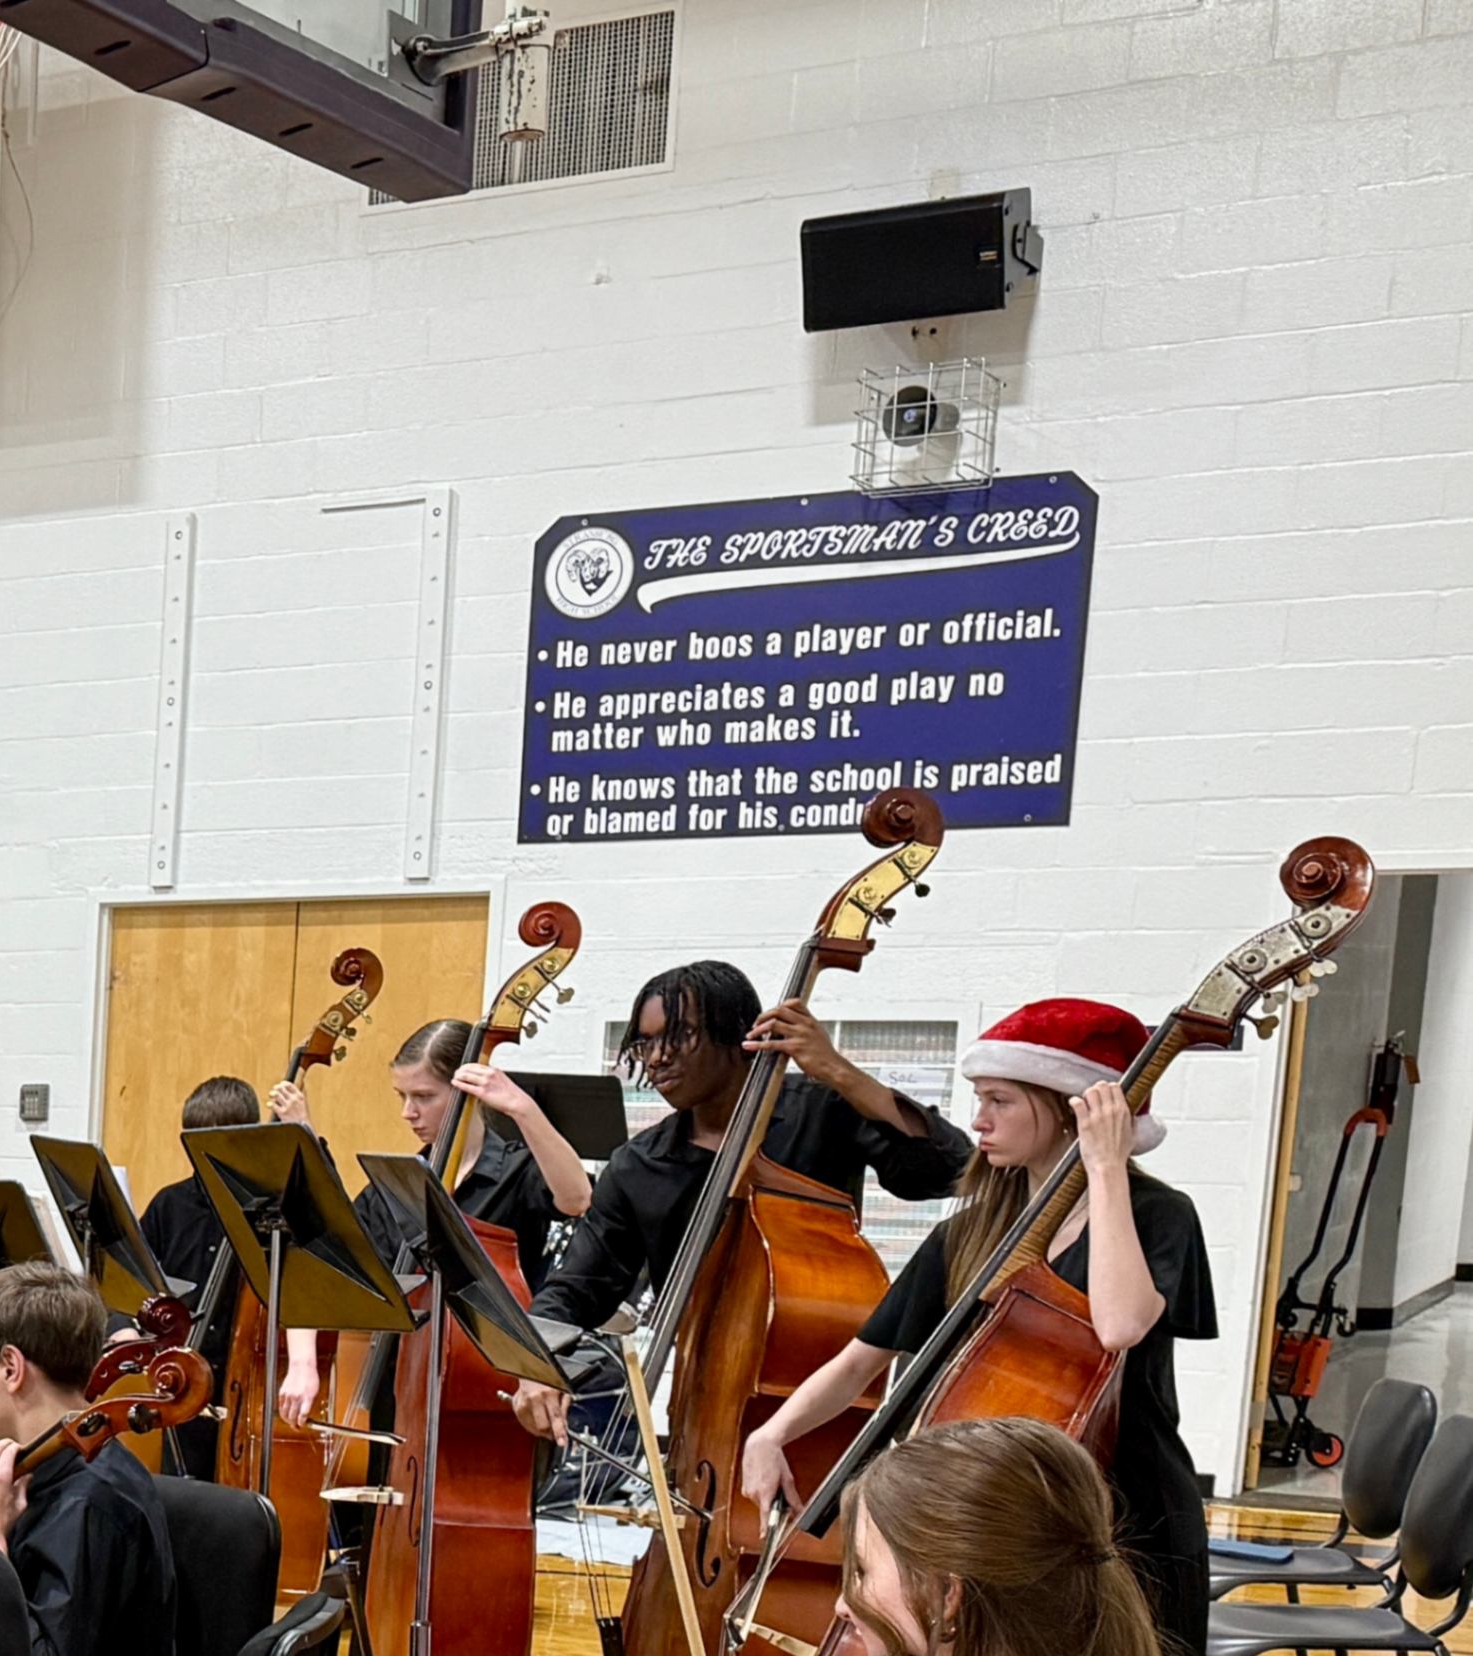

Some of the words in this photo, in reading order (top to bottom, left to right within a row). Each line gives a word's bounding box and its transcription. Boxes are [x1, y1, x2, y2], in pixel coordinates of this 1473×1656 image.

[644, 535, 712, 570] THE
[720, 516, 959, 566] SPORTSMAN'S
[967, 505, 1079, 545] CREED
[556, 640, 589, 668] He
[600, 639, 677, 665] never
[688, 632, 753, 660] boos
[765, 632, 781, 655] a
[794, 623, 886, 658] player
[899, 622, 930, 646] or
[942, 608, 1061, 644] official.
[553, 691, 586, 719] He
[599, 682, 765, 720] appreciates
[778, 684, 795, 707] a
[808, 673, 878, 710] good
[890, 671, 954, 706] play
[968, 672, 1004, 696] no
[552, 722, 644, 752] matter
[657, 718, 711, 746] who
[724, 713, 816, 743] makes
[829, 710, 860, 738] it.
[548, 776, 581, 803] He
[591, 774, 675, 801] knows
[688, 768, 742, 797] that
[755, 767, 798, 795] the
[810, 761, 902, 792] school
[914, 760, 939, 789] is
[951, 754, 1062, 792] praised
[547, 812, 574, 836] or
[584, 804, 677, 835] blamed
[688, 804, 727, 831] for
[738, 801, 778, 829] his
[790, 798, 863, 828] cond
